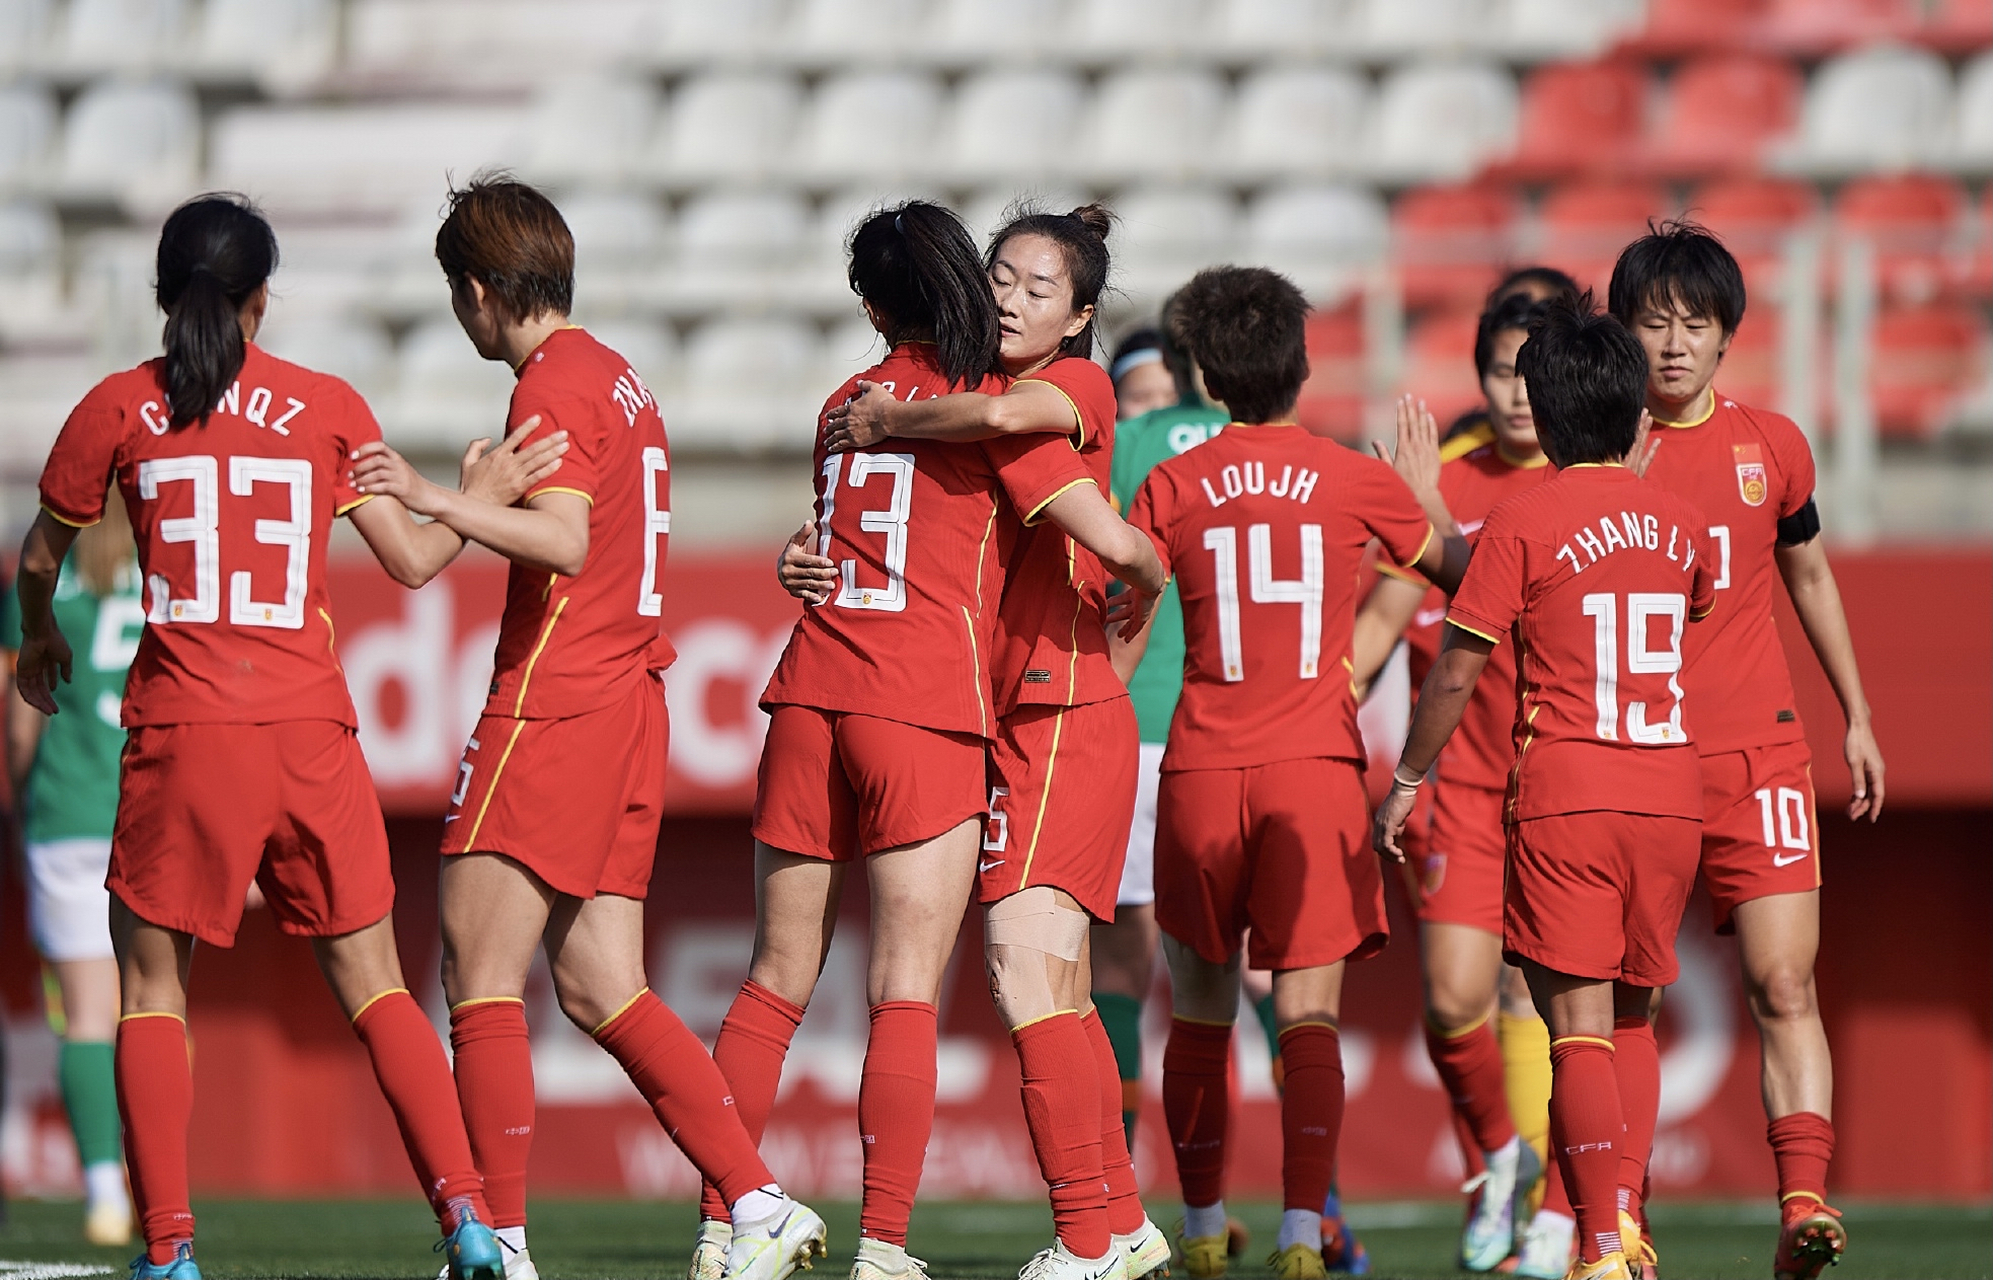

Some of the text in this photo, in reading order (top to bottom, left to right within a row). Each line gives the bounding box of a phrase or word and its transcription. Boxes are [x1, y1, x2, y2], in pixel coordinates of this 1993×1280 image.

[140, 381, 307, 436] CNQZ
[139, 455, 313, 629] 33
[812, 452, 916, 612] 13
[1556, 511, 1659, 574] ZHANG
[1203, 523, 1324, 681] 14
[1582, 592, 1688, 743] 19
[1754, 785, 1811, 851] 10
[1565, 1141, 1612, 1156] CFA
